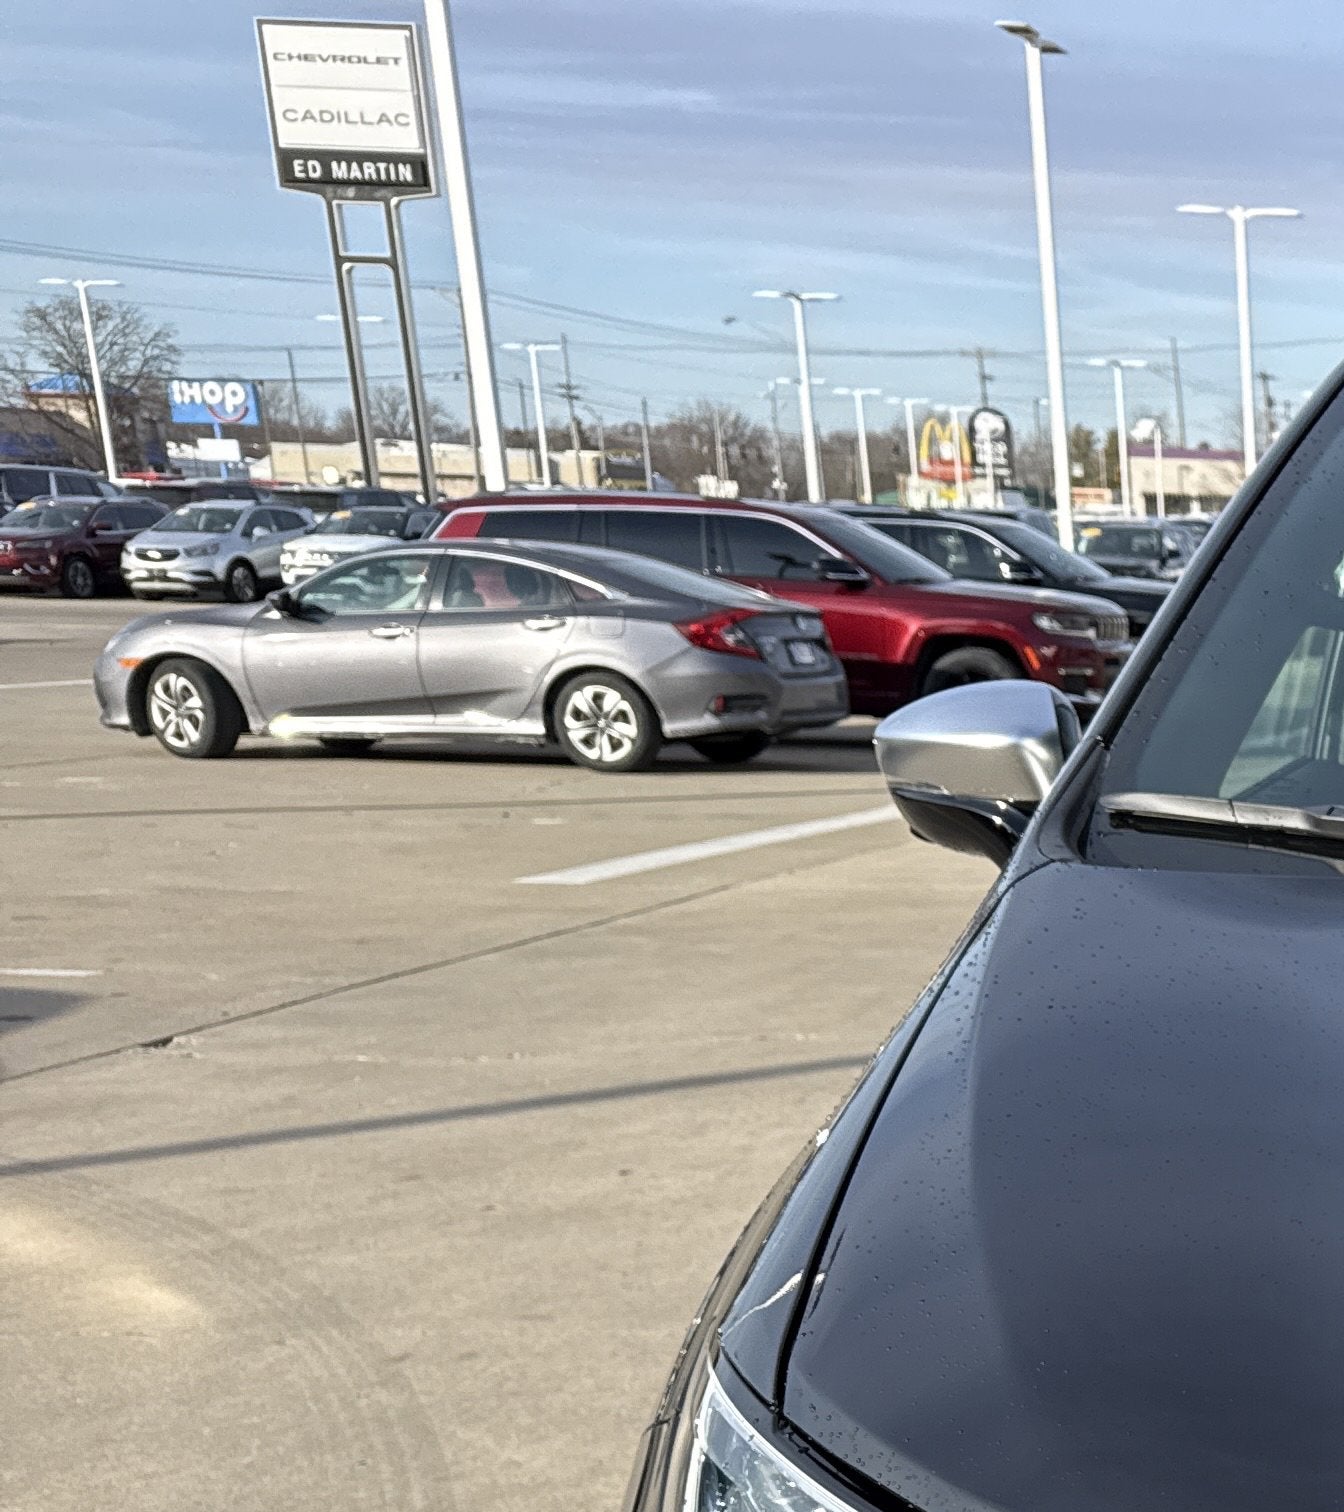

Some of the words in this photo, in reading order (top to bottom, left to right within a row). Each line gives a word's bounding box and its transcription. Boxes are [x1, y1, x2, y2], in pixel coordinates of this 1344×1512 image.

[272, 52, 402, 66] CHEVROLET
[282, 108, 411, 127] CADILLAC
[293, 159, 322, 179] ED
[331, 161, 413, 182] MARTIN
